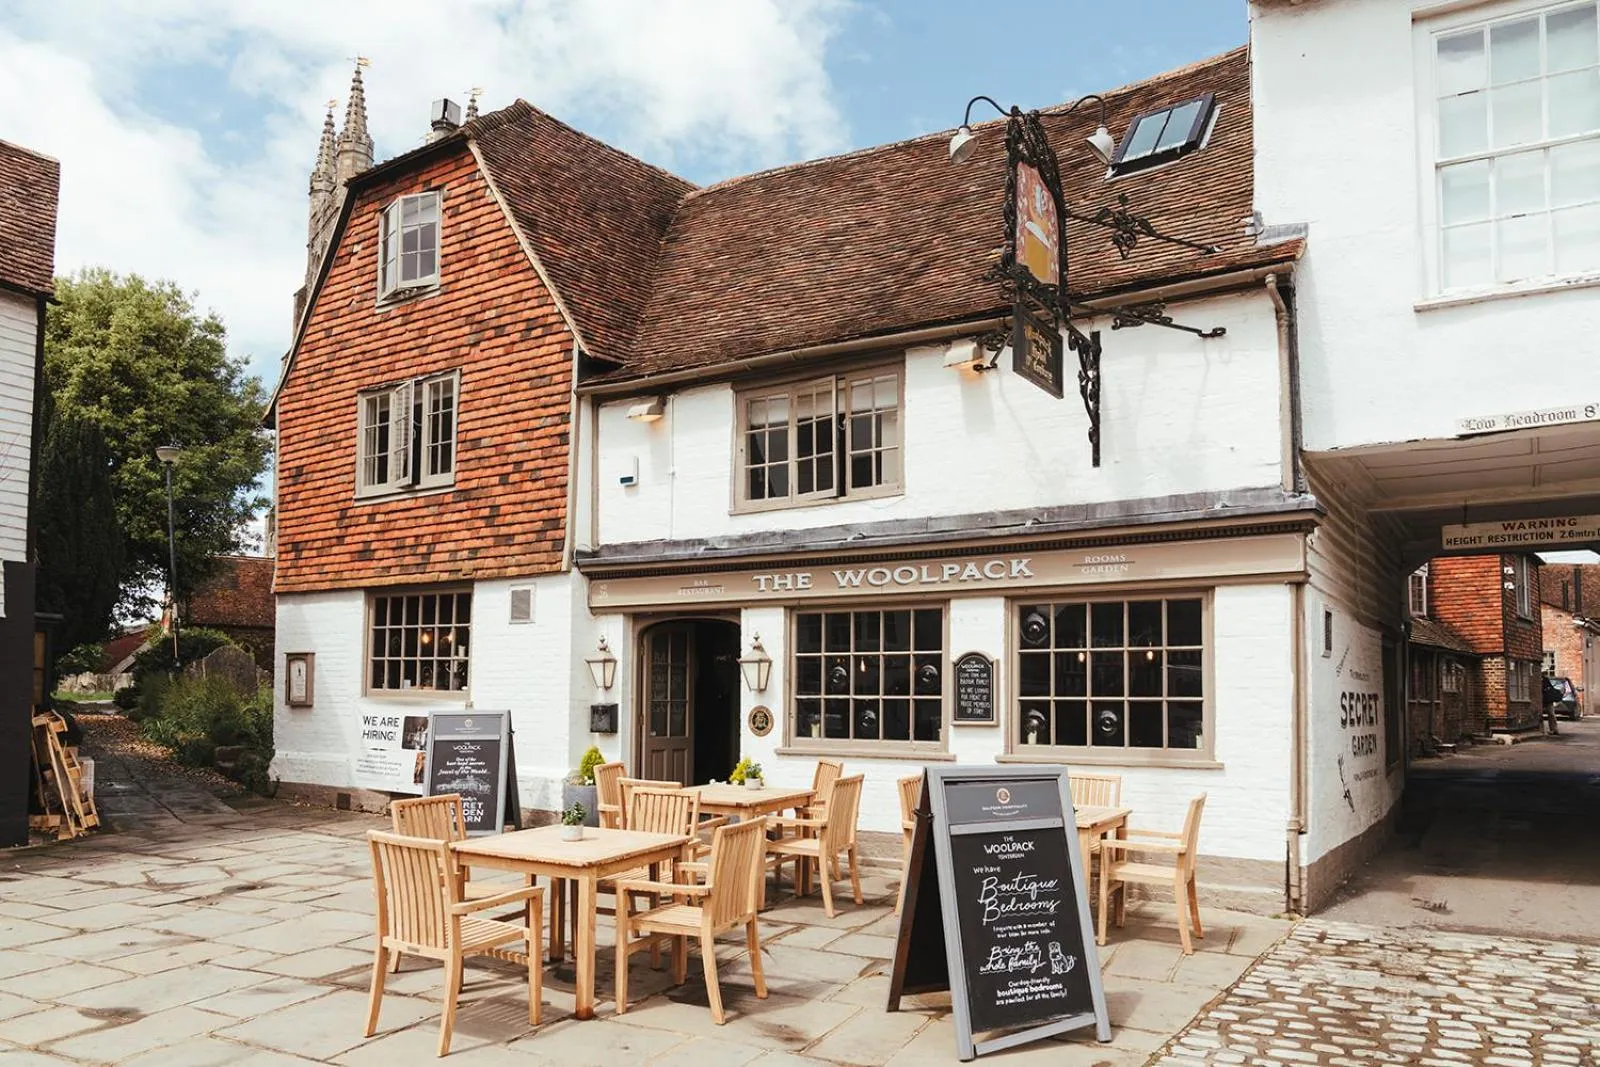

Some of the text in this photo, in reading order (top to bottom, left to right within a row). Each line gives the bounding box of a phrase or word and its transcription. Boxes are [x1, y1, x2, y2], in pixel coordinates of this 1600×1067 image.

[1501, 518, 1578, 531] WARNING
[1446, 535, 1482, 546] HEIGHT
[1487, 530, 1554, 543] RESTRICTION
[1085, 554, 1129, 564] ROOMS
[752, 558, 1034, 592] THE WOOLPACK
[1080, 564, 1129, 573] GARDEN
[1340, 691, 1379, 729] SECRET
[362, 716, 400, 728] WE ARE
[1352, 733, 1377, 757] GARDEN
[984, 841, 1035, 854] WOOLPACK
[973, 865, 1001, 874] We have
[978, 871, 1058, 904] Boutique
[982, 897, 1061, 926] Bedrooms
[987, 940, 1040, 962] Bring the
[980, 958, 1006, 972] whole
[996, 983, 1063, 998] boutique bedrooms
